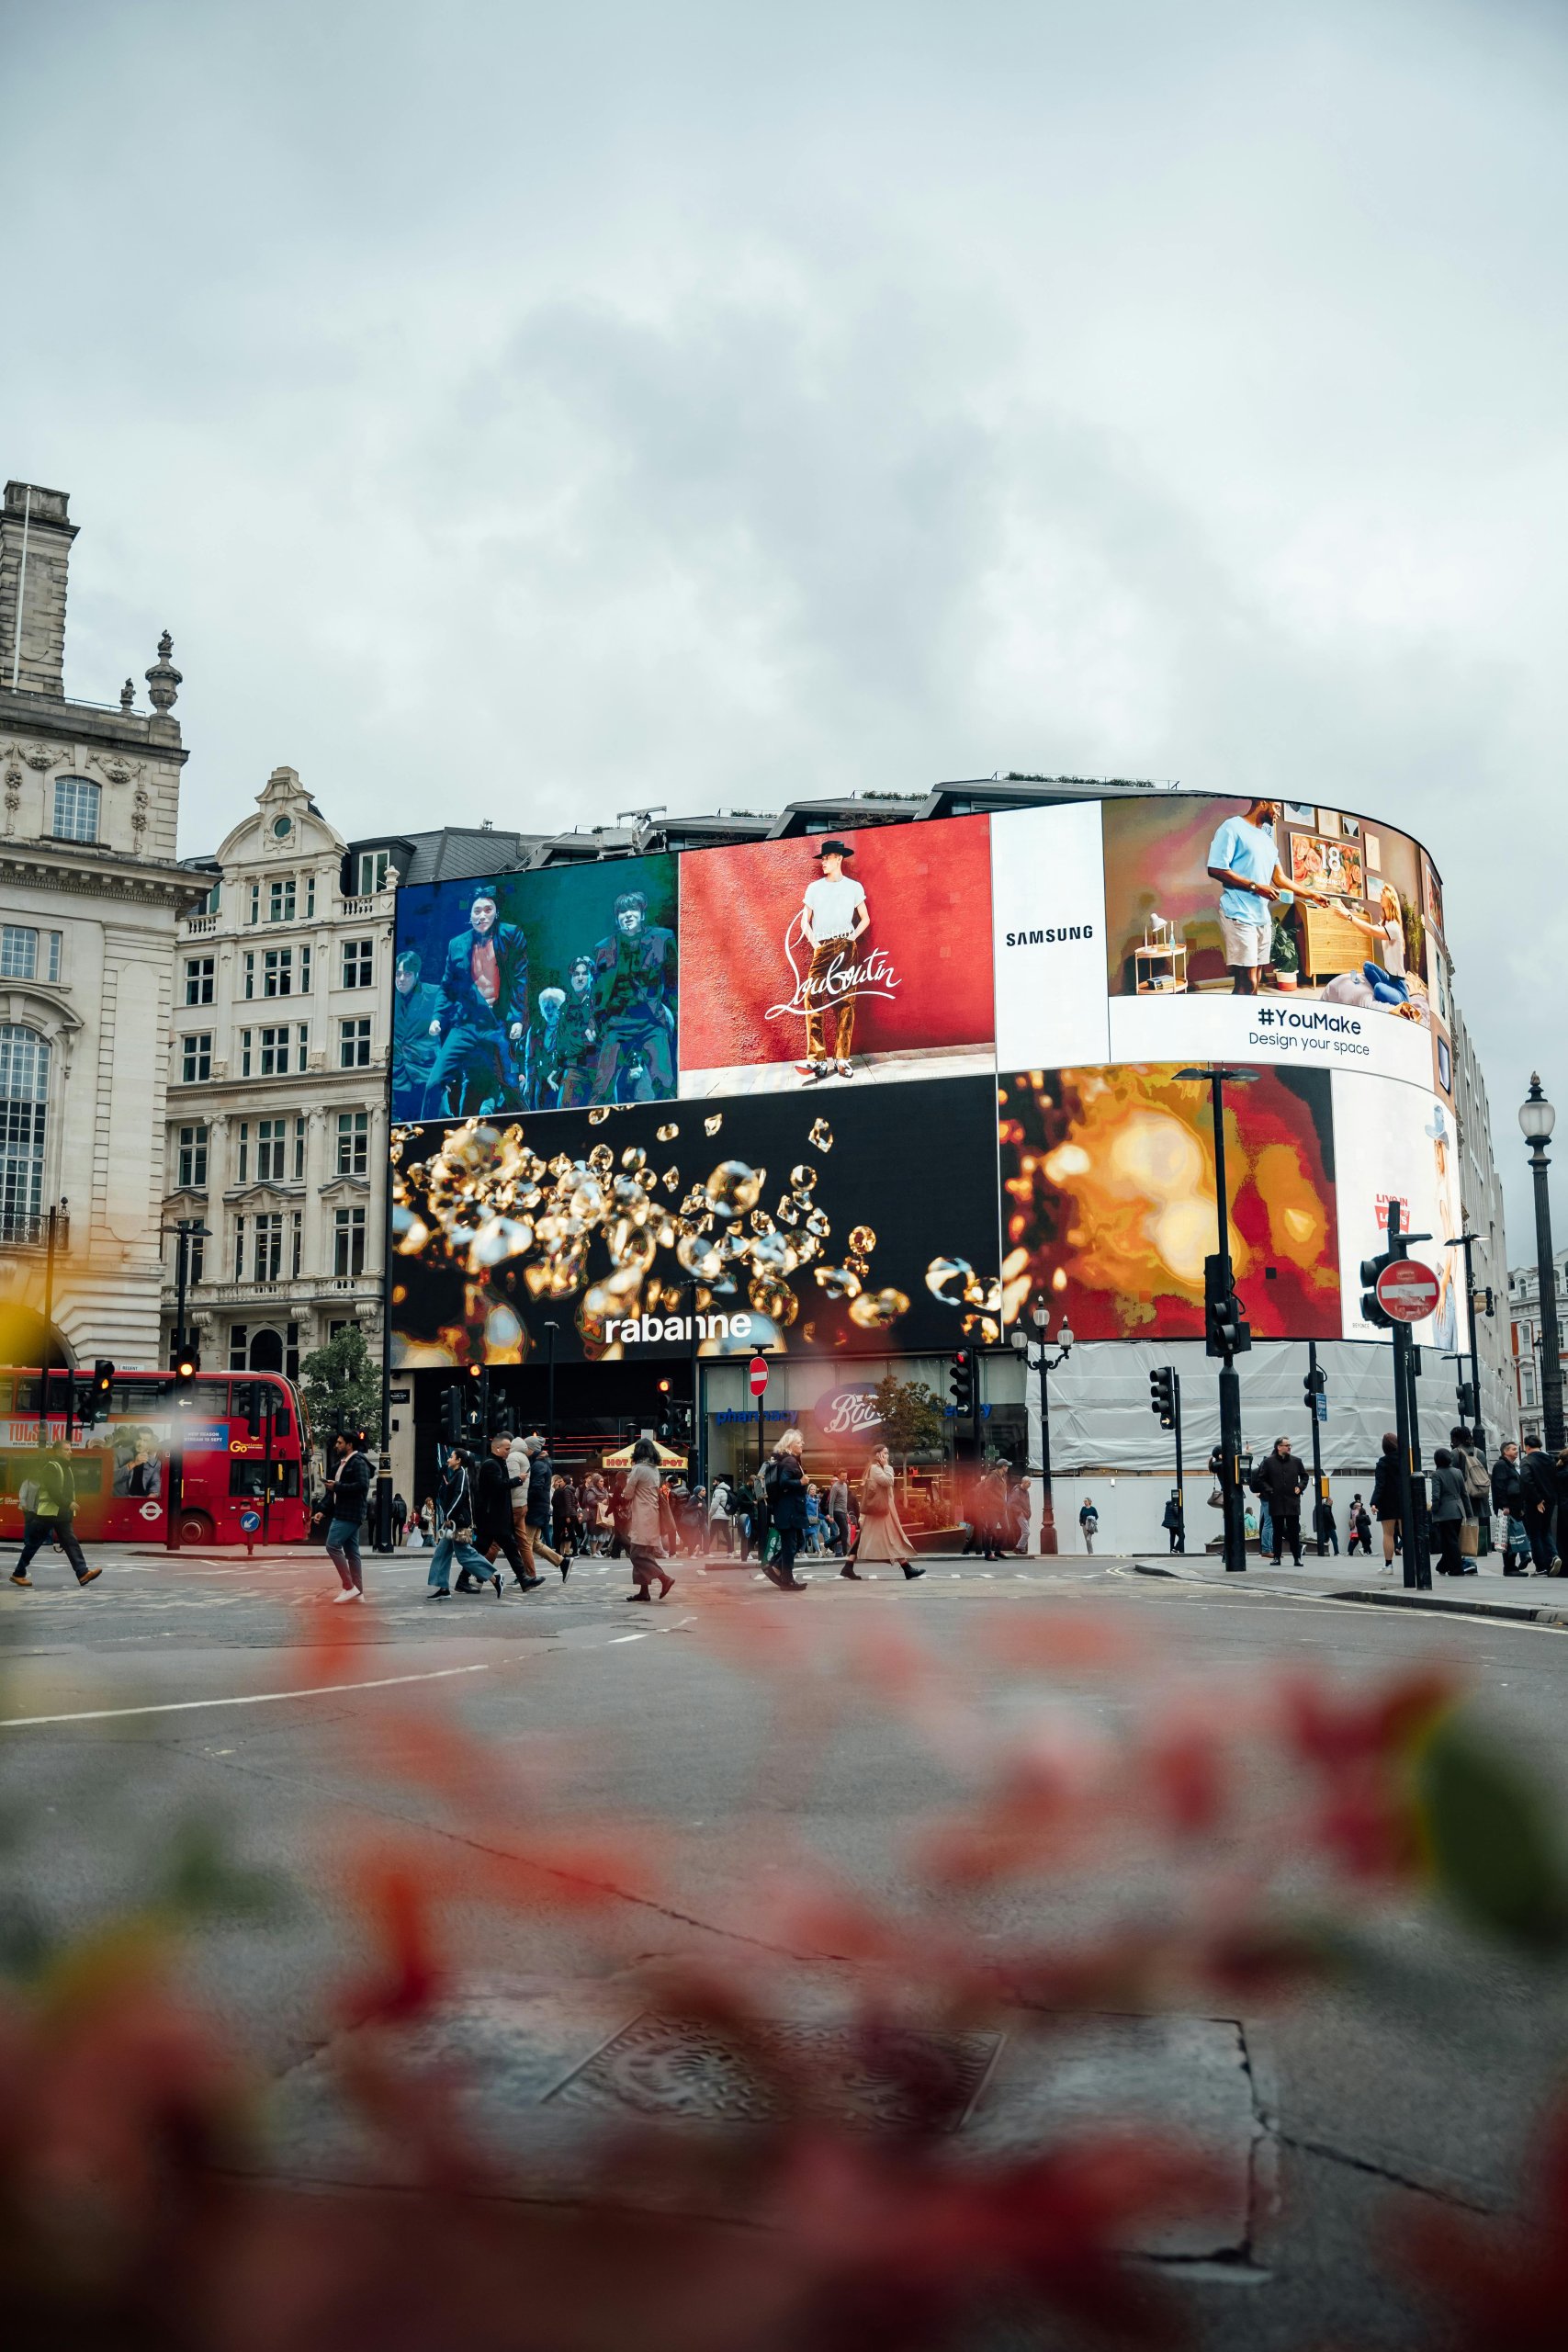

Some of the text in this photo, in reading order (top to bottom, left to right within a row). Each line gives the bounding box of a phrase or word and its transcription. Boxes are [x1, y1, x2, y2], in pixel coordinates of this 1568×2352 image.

[1319, 843, 1341, 872] 18
[1006, 925, 1093, 946] SAMSUNG
[764, 908, 902, 1020] Louboutin
[1258, 1008, 1361, 1035] #YouMake
[1249, 1032, 1370, 1055] Design your space
[605, 1313, 751, 1343] rabanne
[823, 1394, 897, 1433] Boo
[51, 1423, 83, 1443] KIG
[230, 1441, 247, 1453] Go
[606, 1458, 628, 1466] HOT
